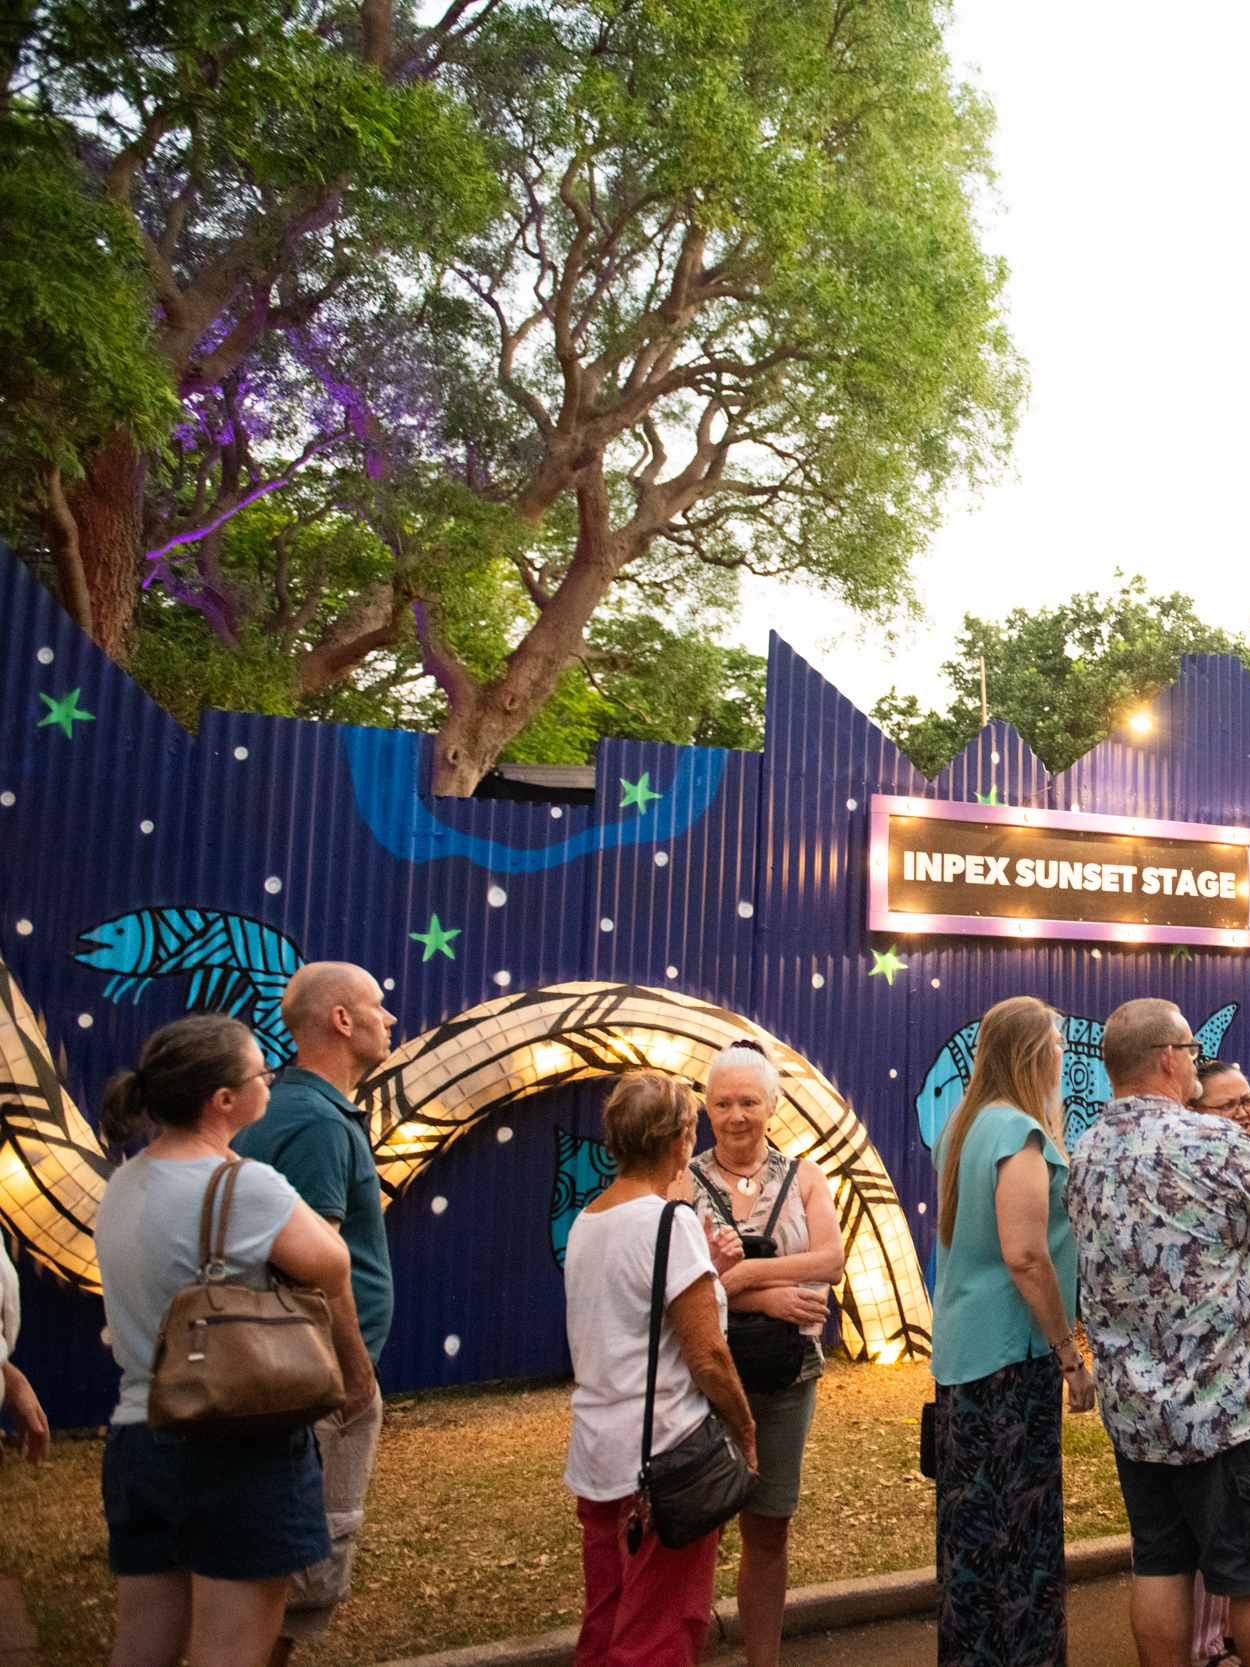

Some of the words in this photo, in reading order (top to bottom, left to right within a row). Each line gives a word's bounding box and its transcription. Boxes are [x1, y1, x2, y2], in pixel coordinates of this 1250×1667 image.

[903, 850, 1011, 886] INPEX
[1014, 858, 1138, 893] SUNSET
[1141, 866, 1237, 899] STAGE
